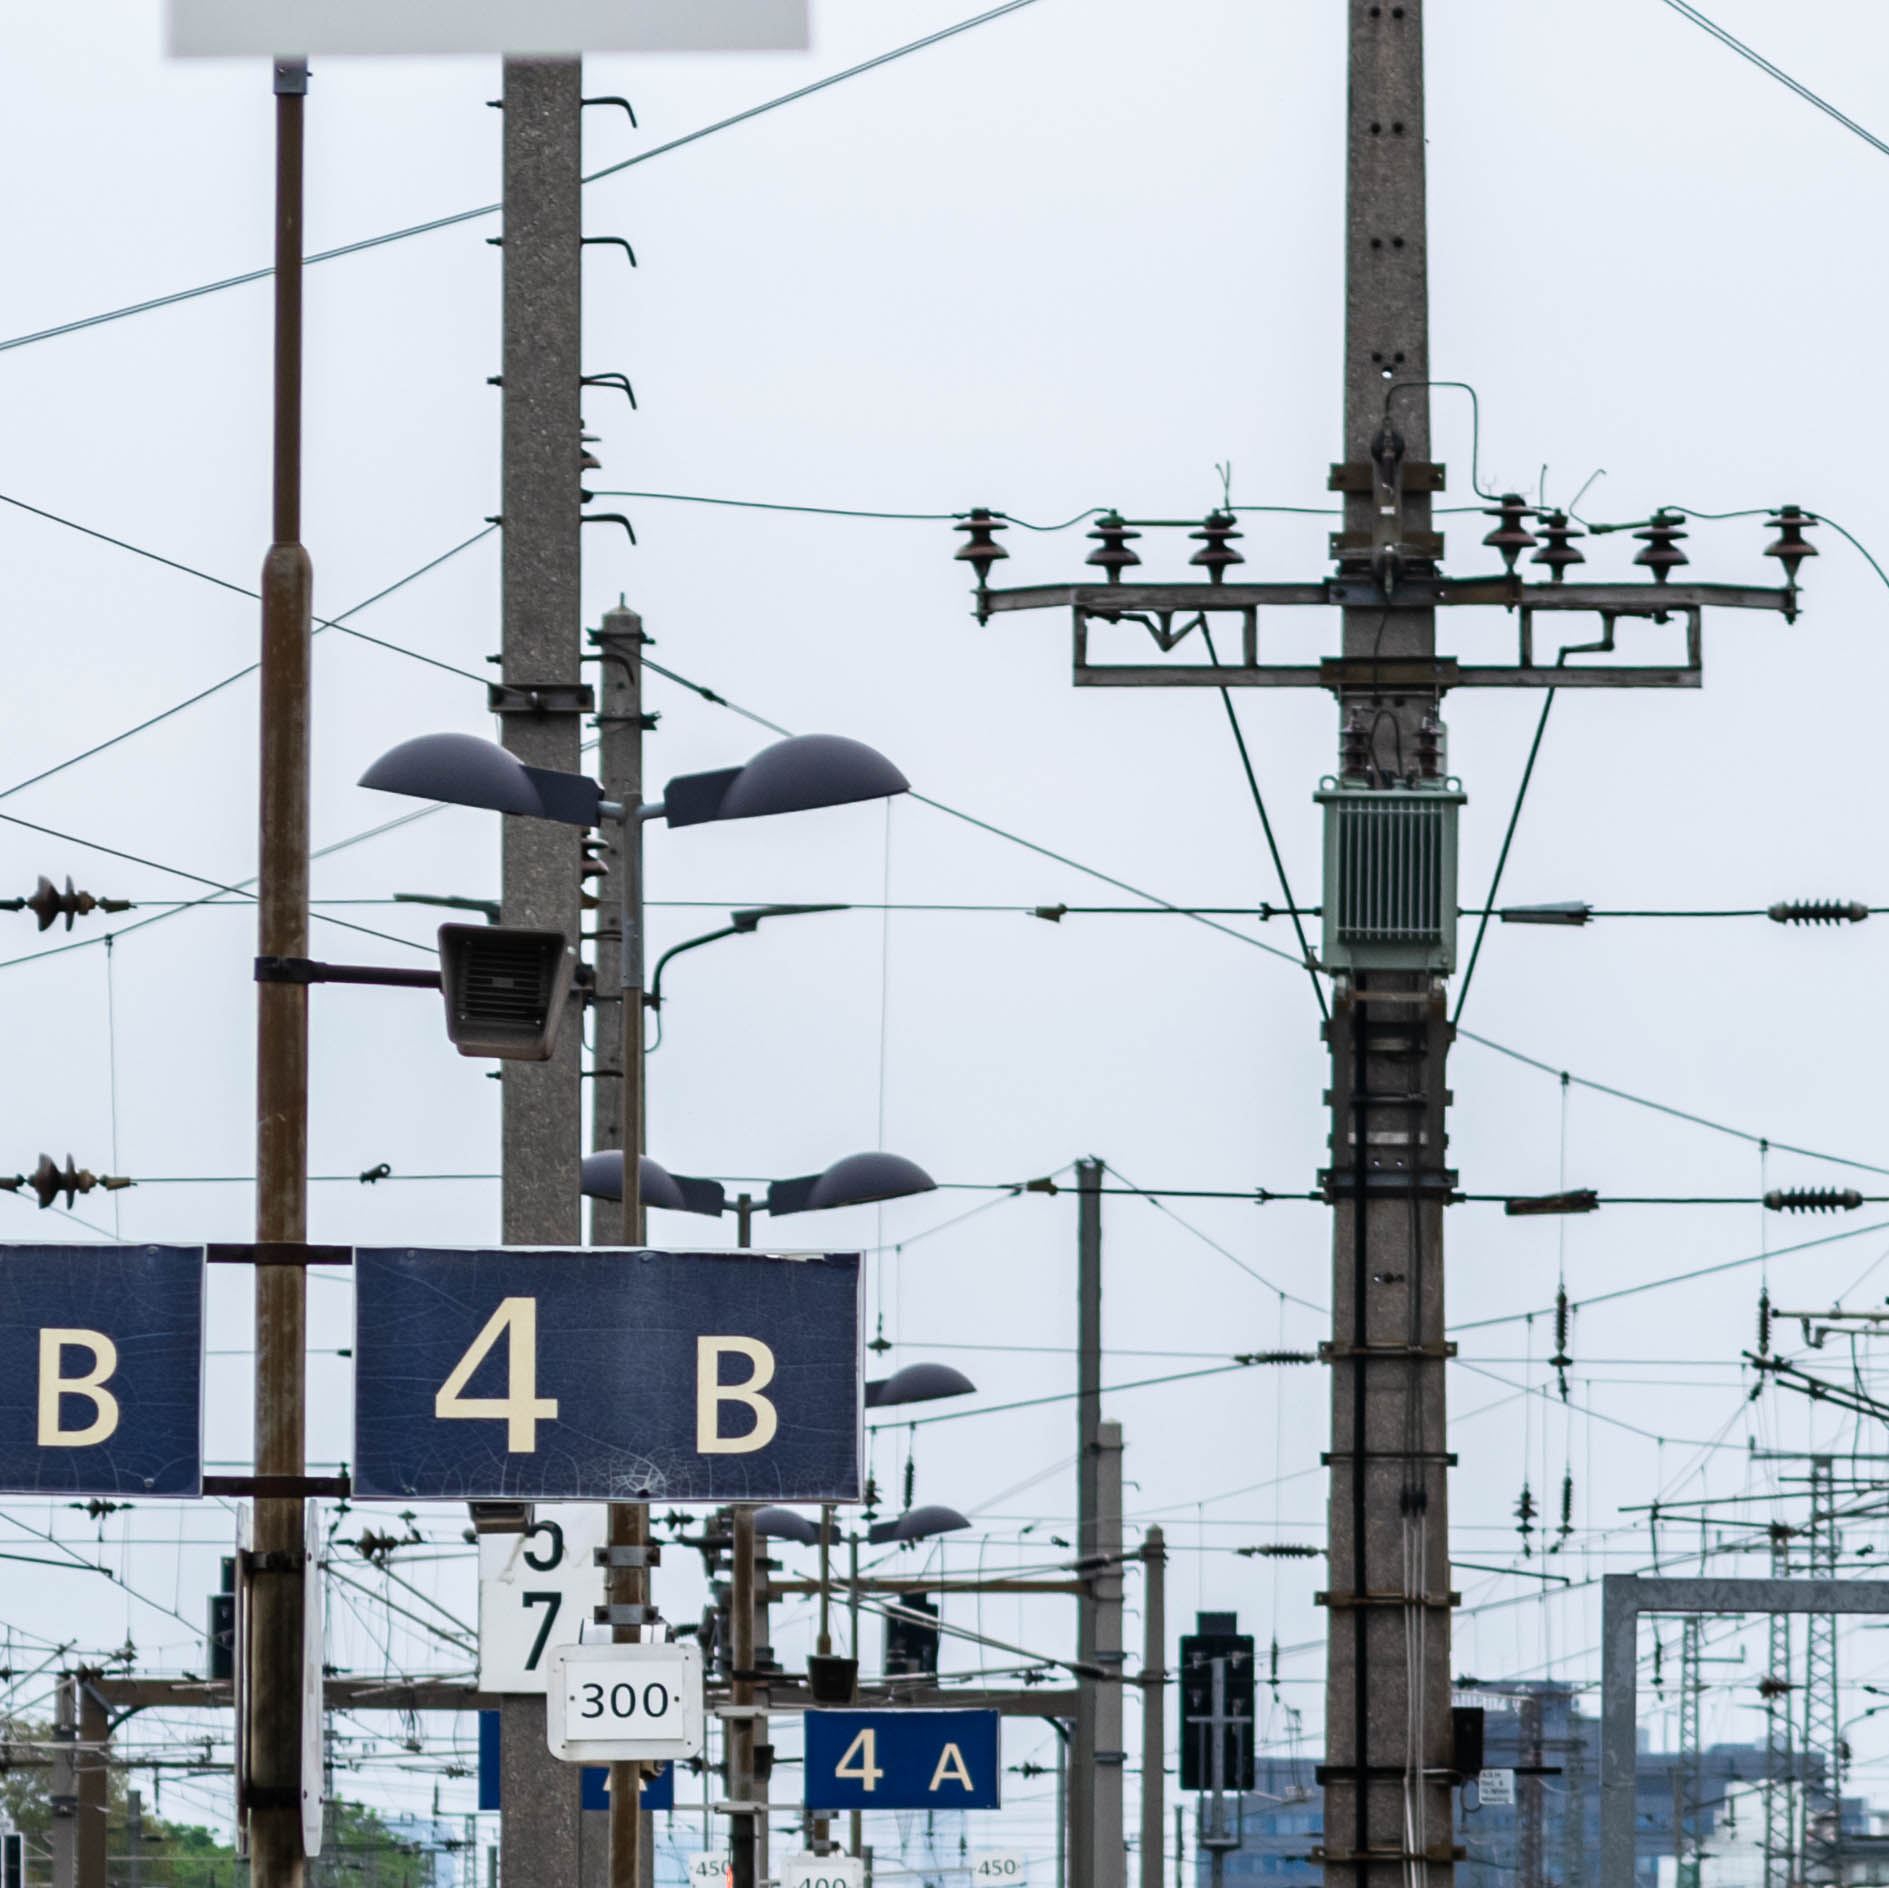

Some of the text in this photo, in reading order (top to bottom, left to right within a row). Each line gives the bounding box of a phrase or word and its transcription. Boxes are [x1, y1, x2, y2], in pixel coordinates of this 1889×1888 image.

[37, 1328, 119, 1448] B
[434, 1297, 778, 1455] 4 B
[522, 1591, 562, 1672] 7
[580, 1682, 669, 1719] 300
[836, 1728, 974, 1791] 4 A
[978, 1858, 1017, 1877] 450
